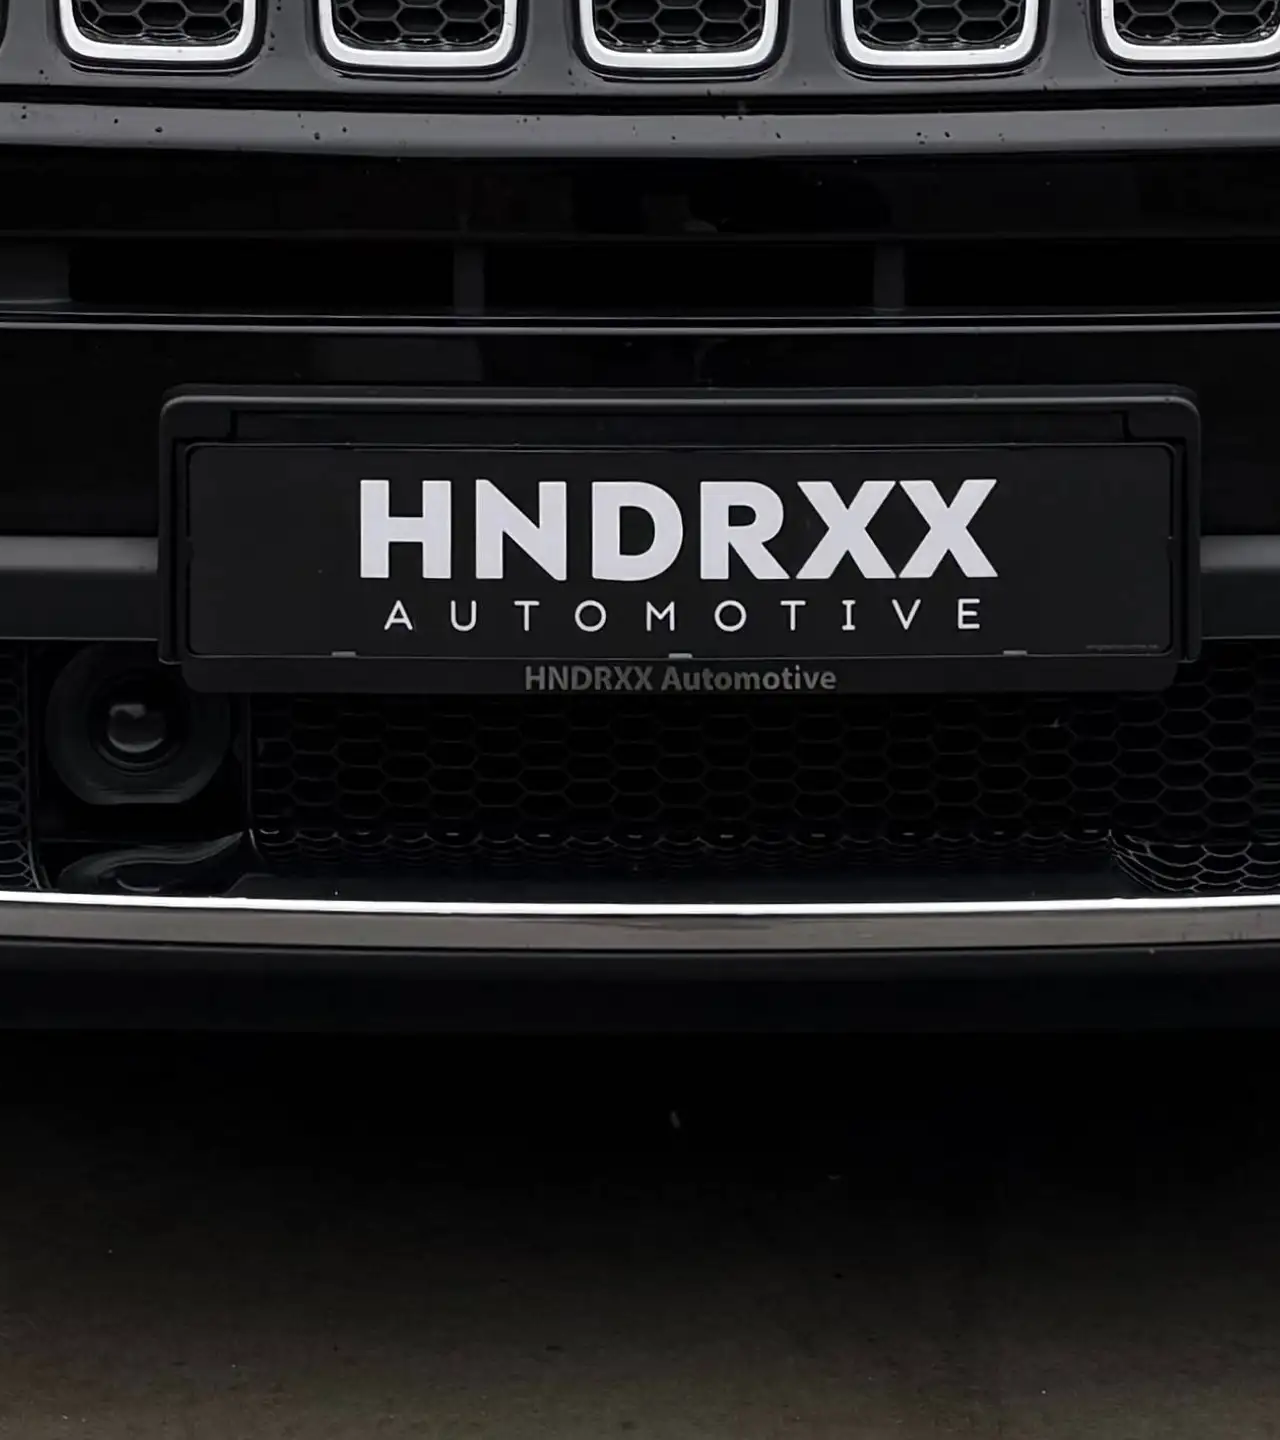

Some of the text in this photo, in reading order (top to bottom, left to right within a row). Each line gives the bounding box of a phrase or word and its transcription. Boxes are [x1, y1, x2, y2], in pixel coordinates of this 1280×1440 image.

[359, 478, 999, 582] HNDRXX
[383, 598, 981, 633] AUTOMOTIVE
[523, 664, 838, 691] HNDRXX Automotive
